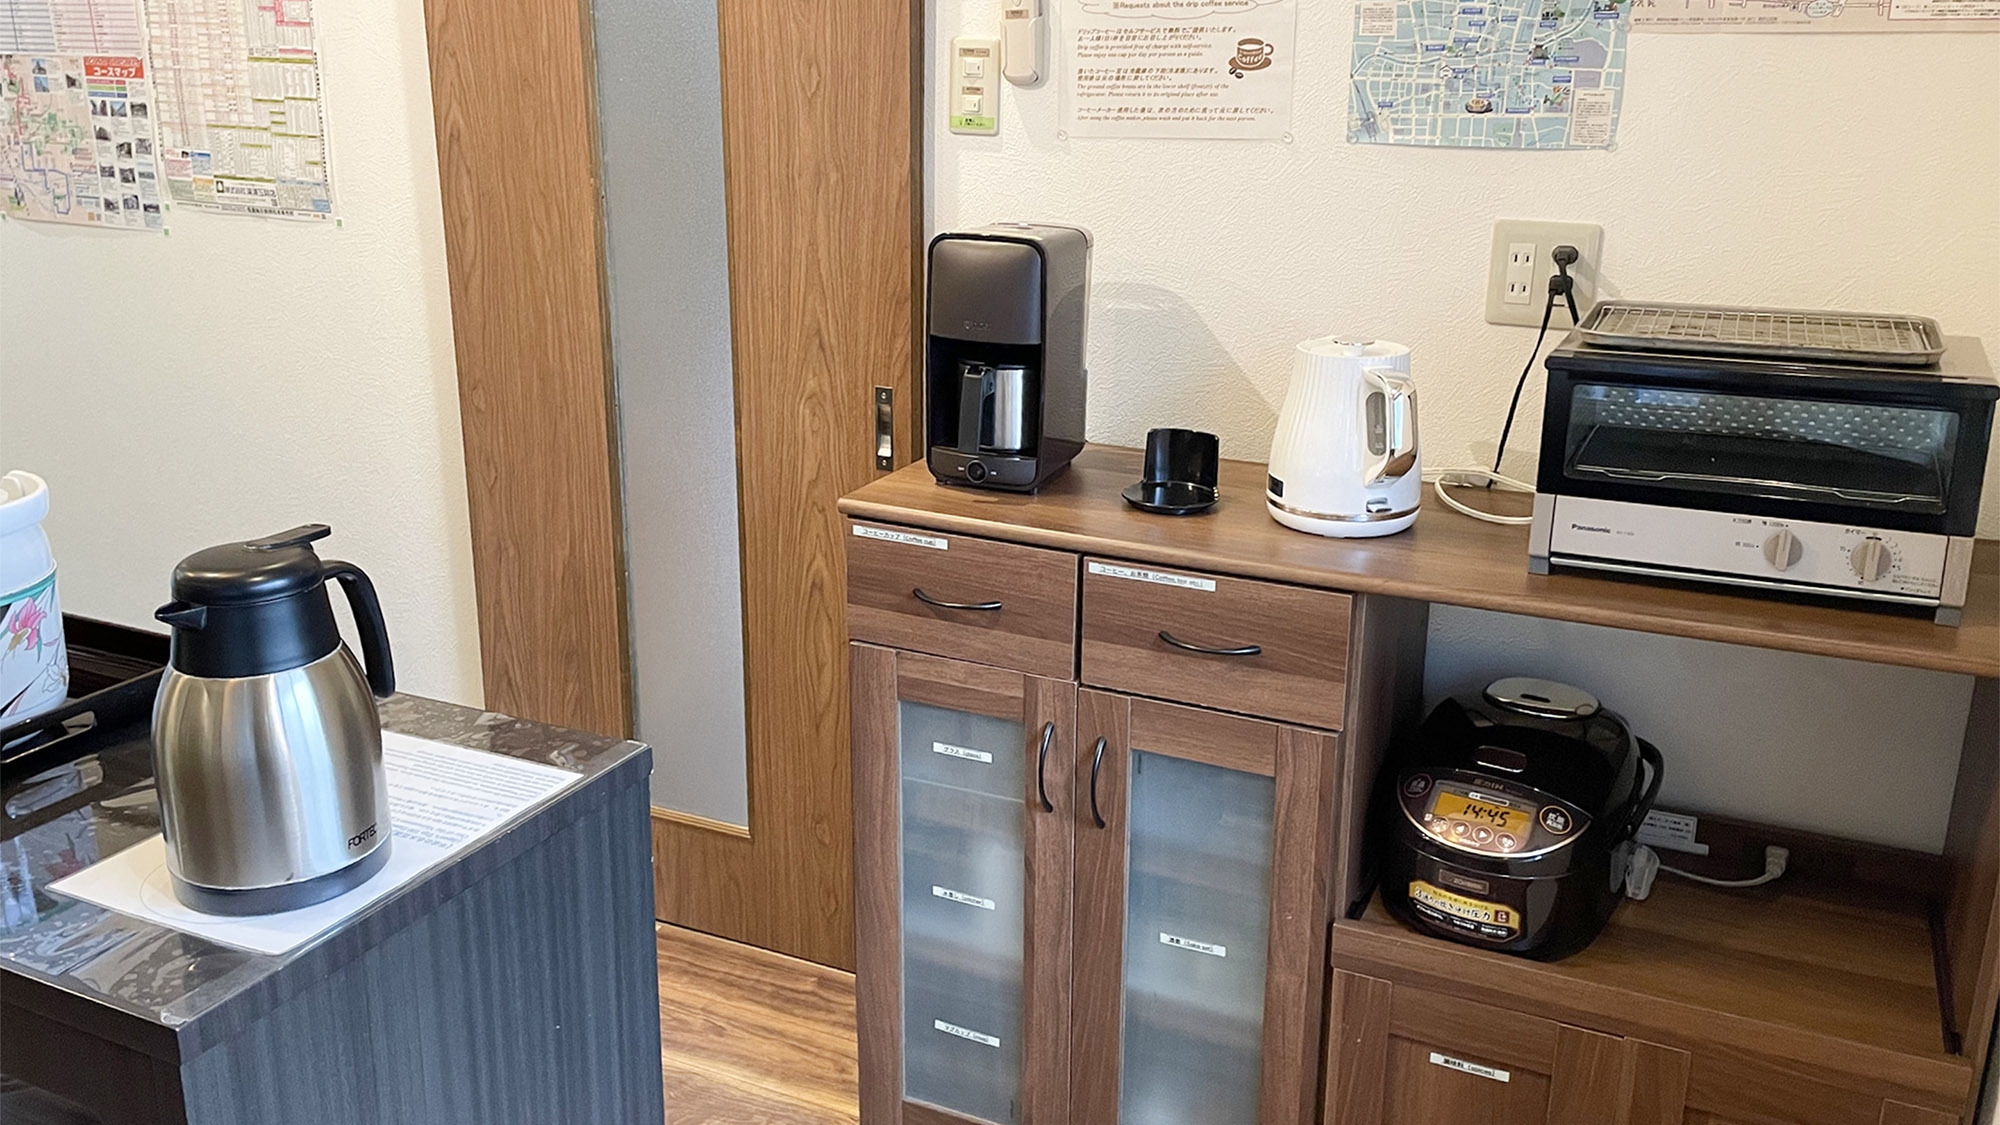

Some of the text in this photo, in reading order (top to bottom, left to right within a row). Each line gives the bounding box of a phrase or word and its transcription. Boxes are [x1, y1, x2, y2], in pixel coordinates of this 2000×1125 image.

[93, 66, 136, 77] コースマップ
[1571, 523, 1611, 534] Panasonic
[1463, 804, 1510, 827] 14:45
